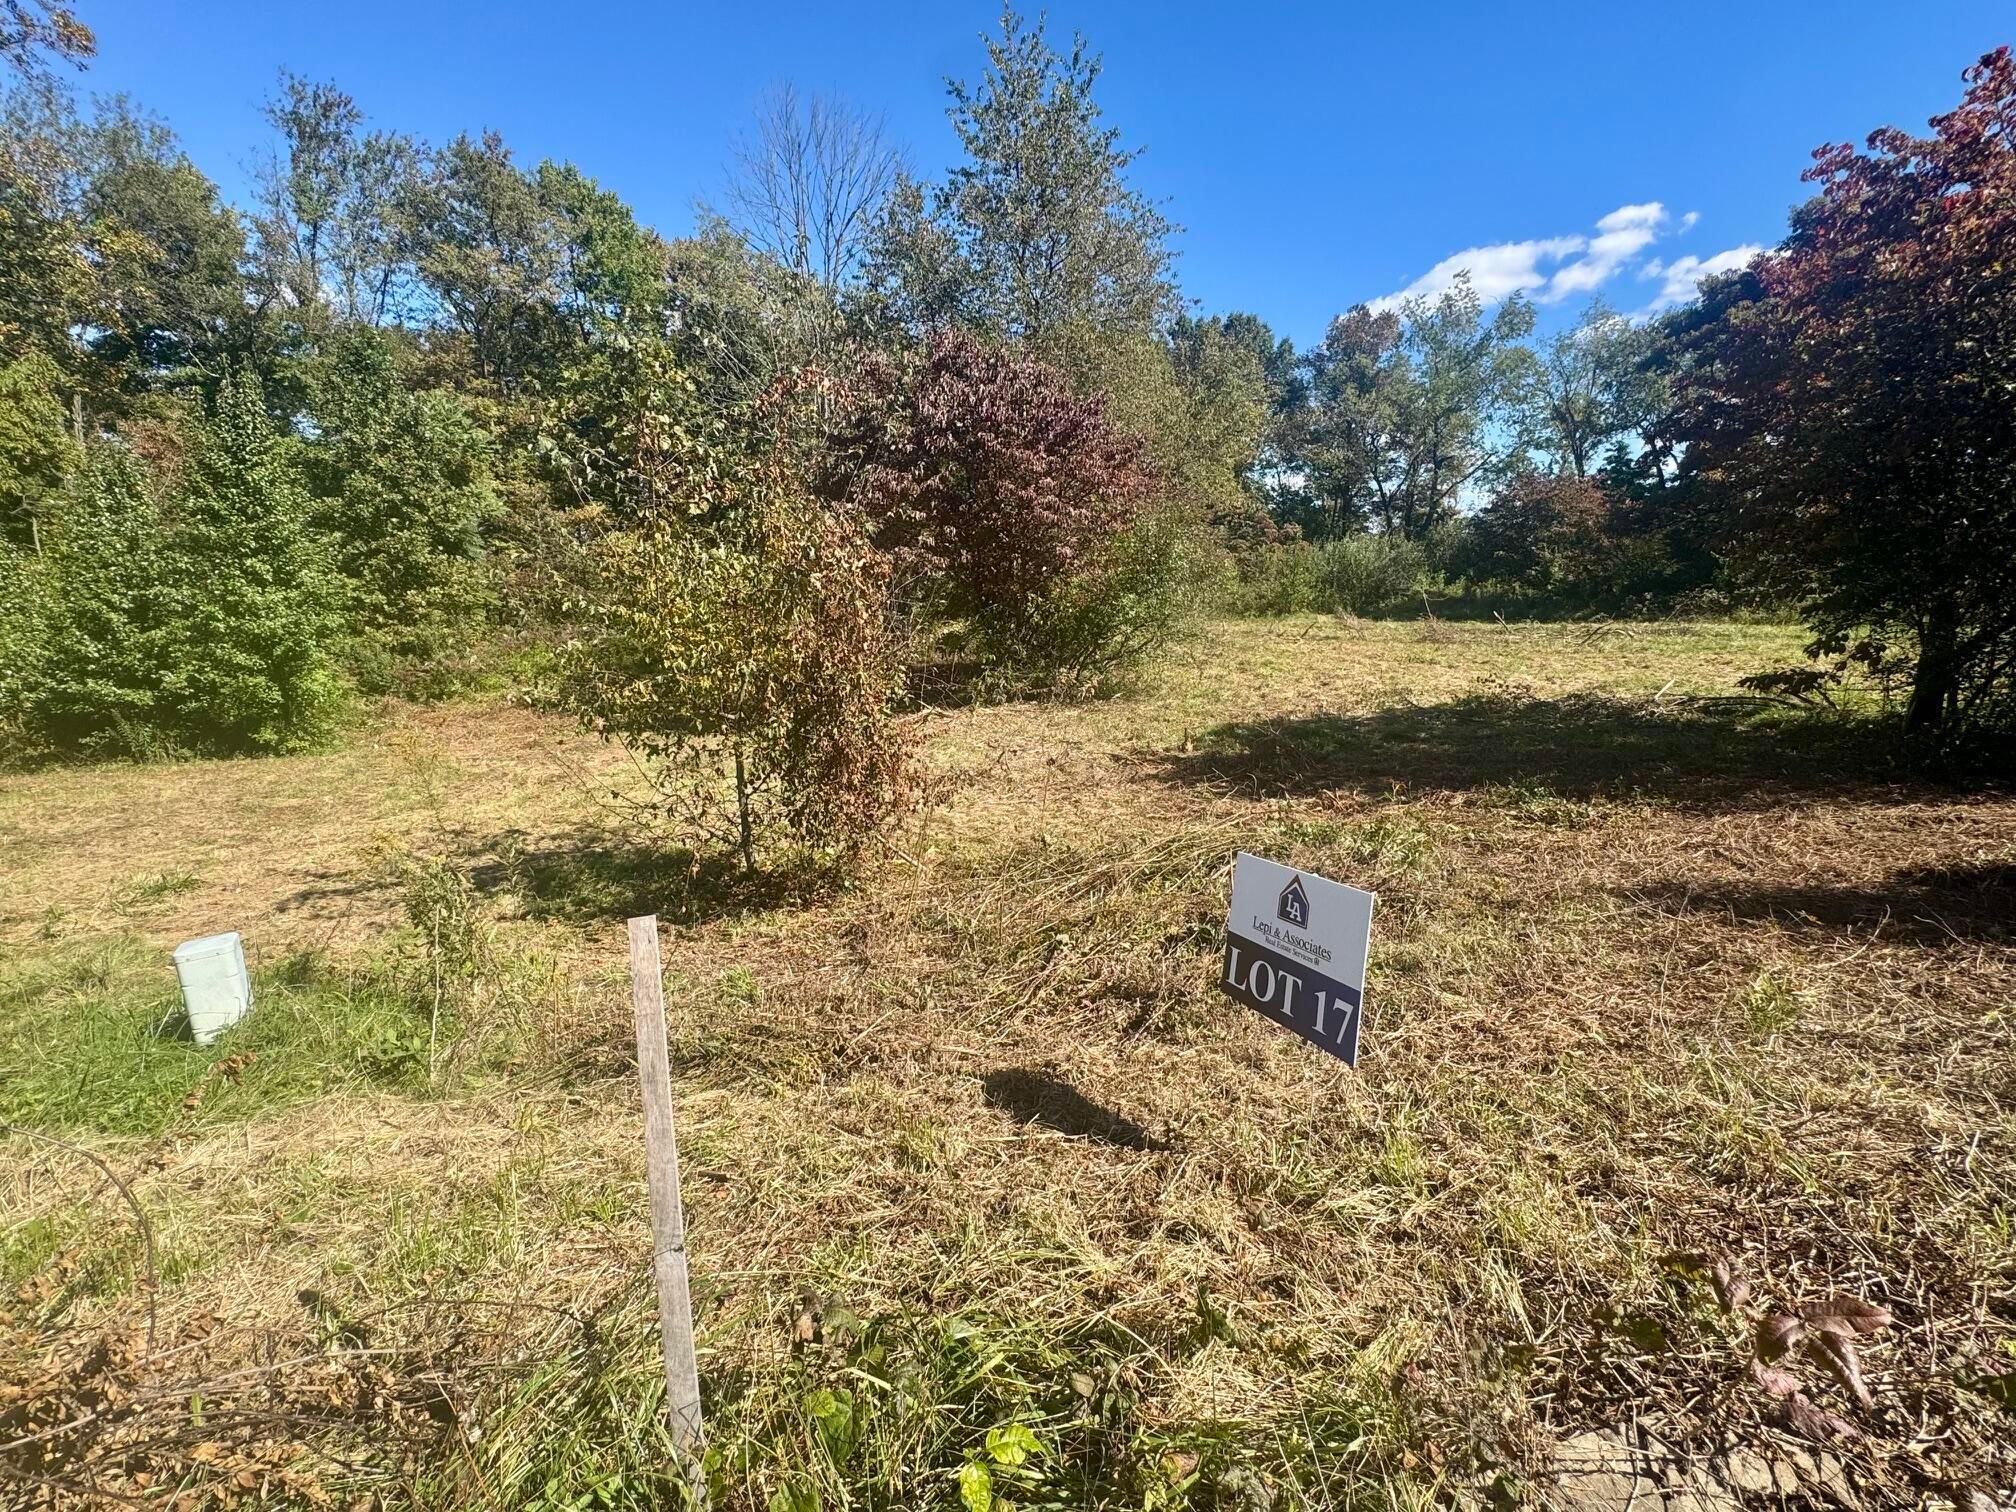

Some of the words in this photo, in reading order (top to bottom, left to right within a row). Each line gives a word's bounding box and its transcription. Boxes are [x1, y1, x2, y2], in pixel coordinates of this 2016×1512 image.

[1286, 894, 1302, 921] LA
[1252, 915, 1273, 935] Lepi
[1273, 927, 1281, 937] &
[1282, 929, 1332, 960] Associates
[1265, 936, 1276, 946] Real
[1276, 939, 1291, 953] Estate
[1292, 947, 1314, 964] Services
[1226, 945, 1302, 1018] LOT
[1311, 991, 1354, 1044] 17
